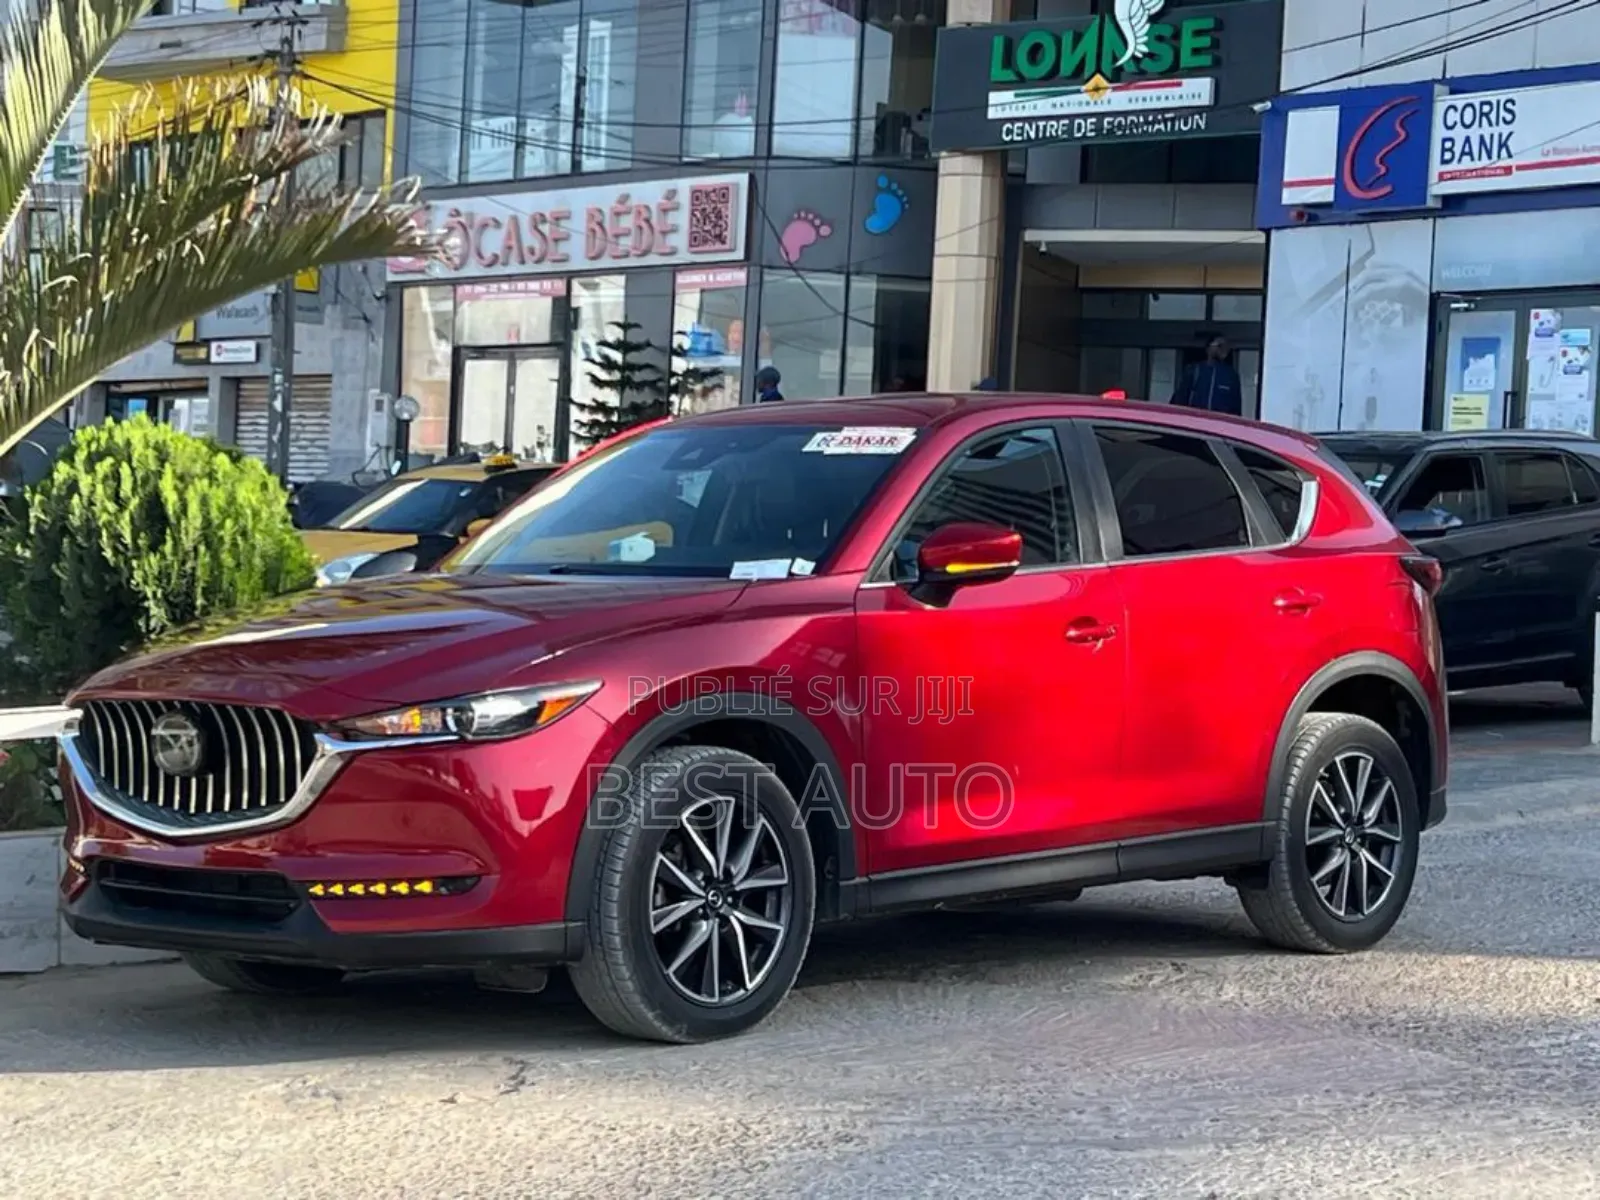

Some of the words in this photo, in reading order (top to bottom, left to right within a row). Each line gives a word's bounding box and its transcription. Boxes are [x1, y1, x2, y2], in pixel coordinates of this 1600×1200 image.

[990, 13, 1216, 82] LONASE
[1002, 120, 1069, 141] CENTRE
[1073, 118, 1096, 137] DE
[1103, 114, 1207, 136] FORMATION
[1443, 98, 1517, 131] CORIS
[1440, 131, 1514, 165] BANK
[585, 188, 682, 260] BÉBÉ
